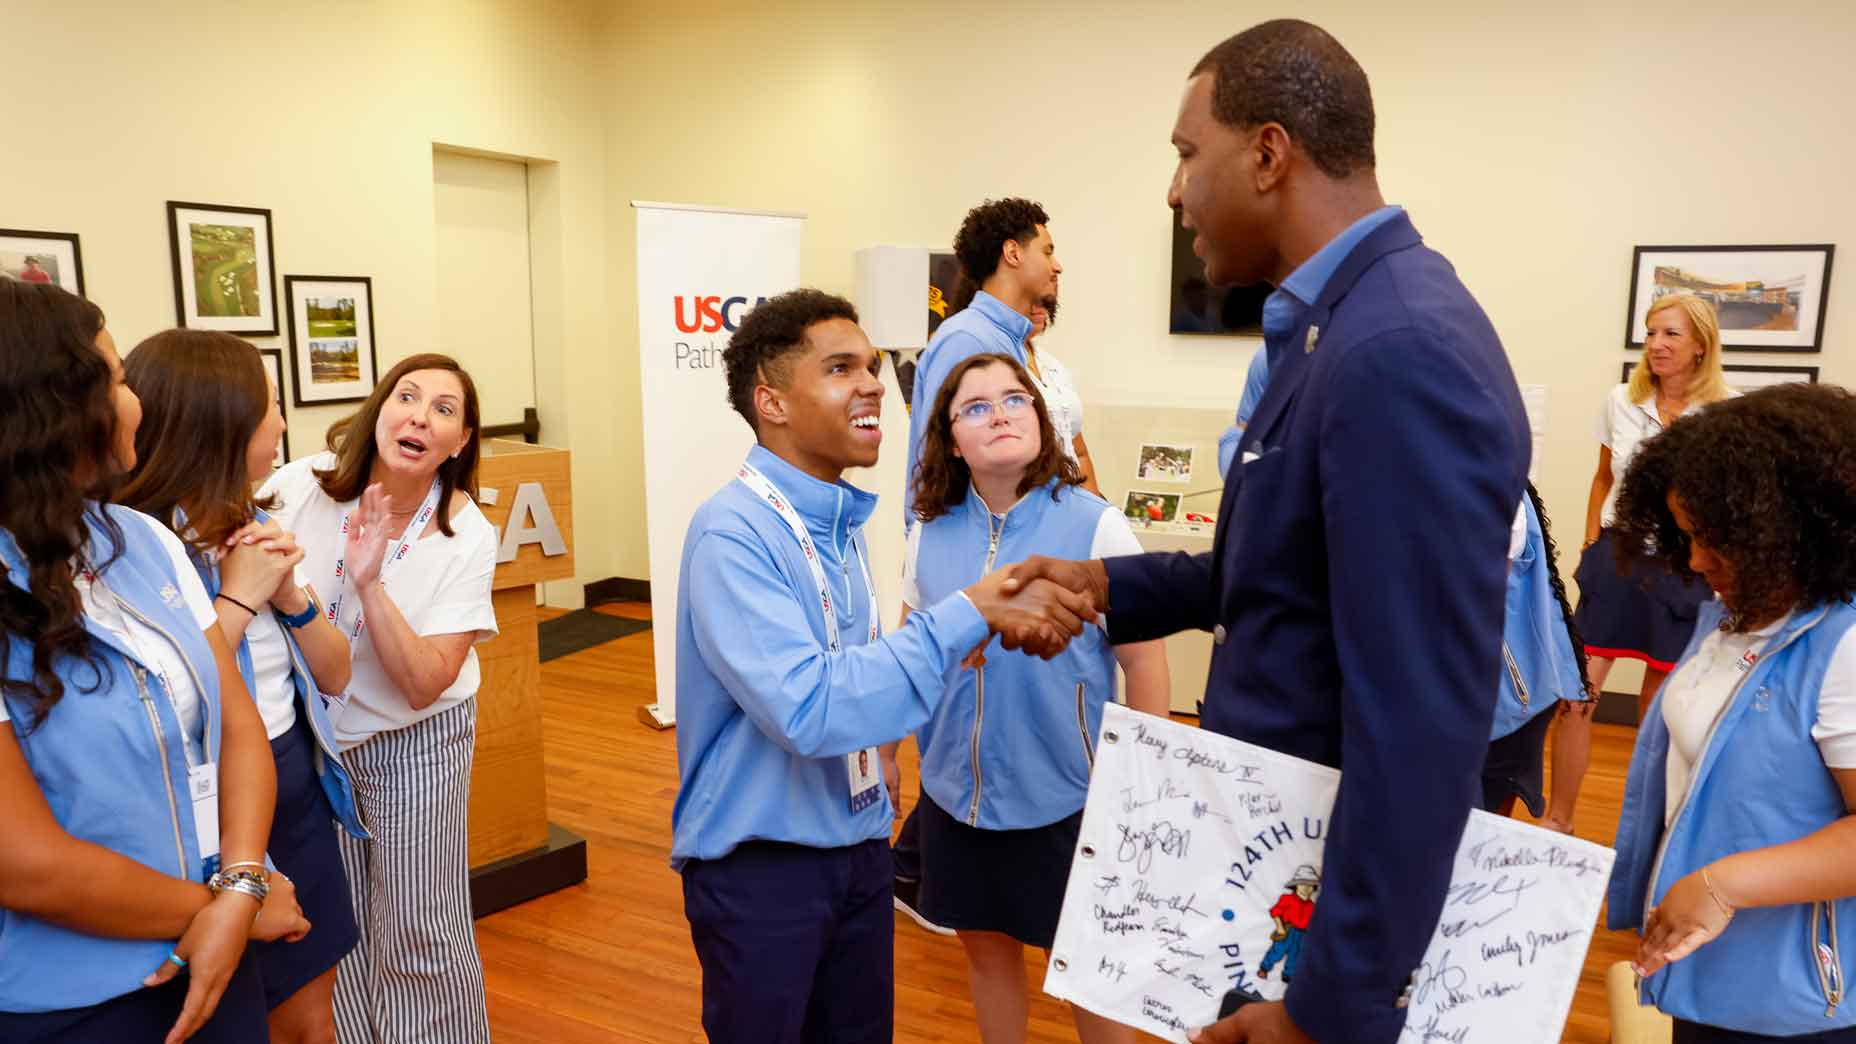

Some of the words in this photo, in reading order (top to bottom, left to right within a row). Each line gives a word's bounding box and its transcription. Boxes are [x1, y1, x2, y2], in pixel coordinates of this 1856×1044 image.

[674, 295, 767, 334] USG
[675, 341, 724, 369] Path
[1226, 821, 1294, 890] 124TH
[1218, 943, 1264, 999] PIN
